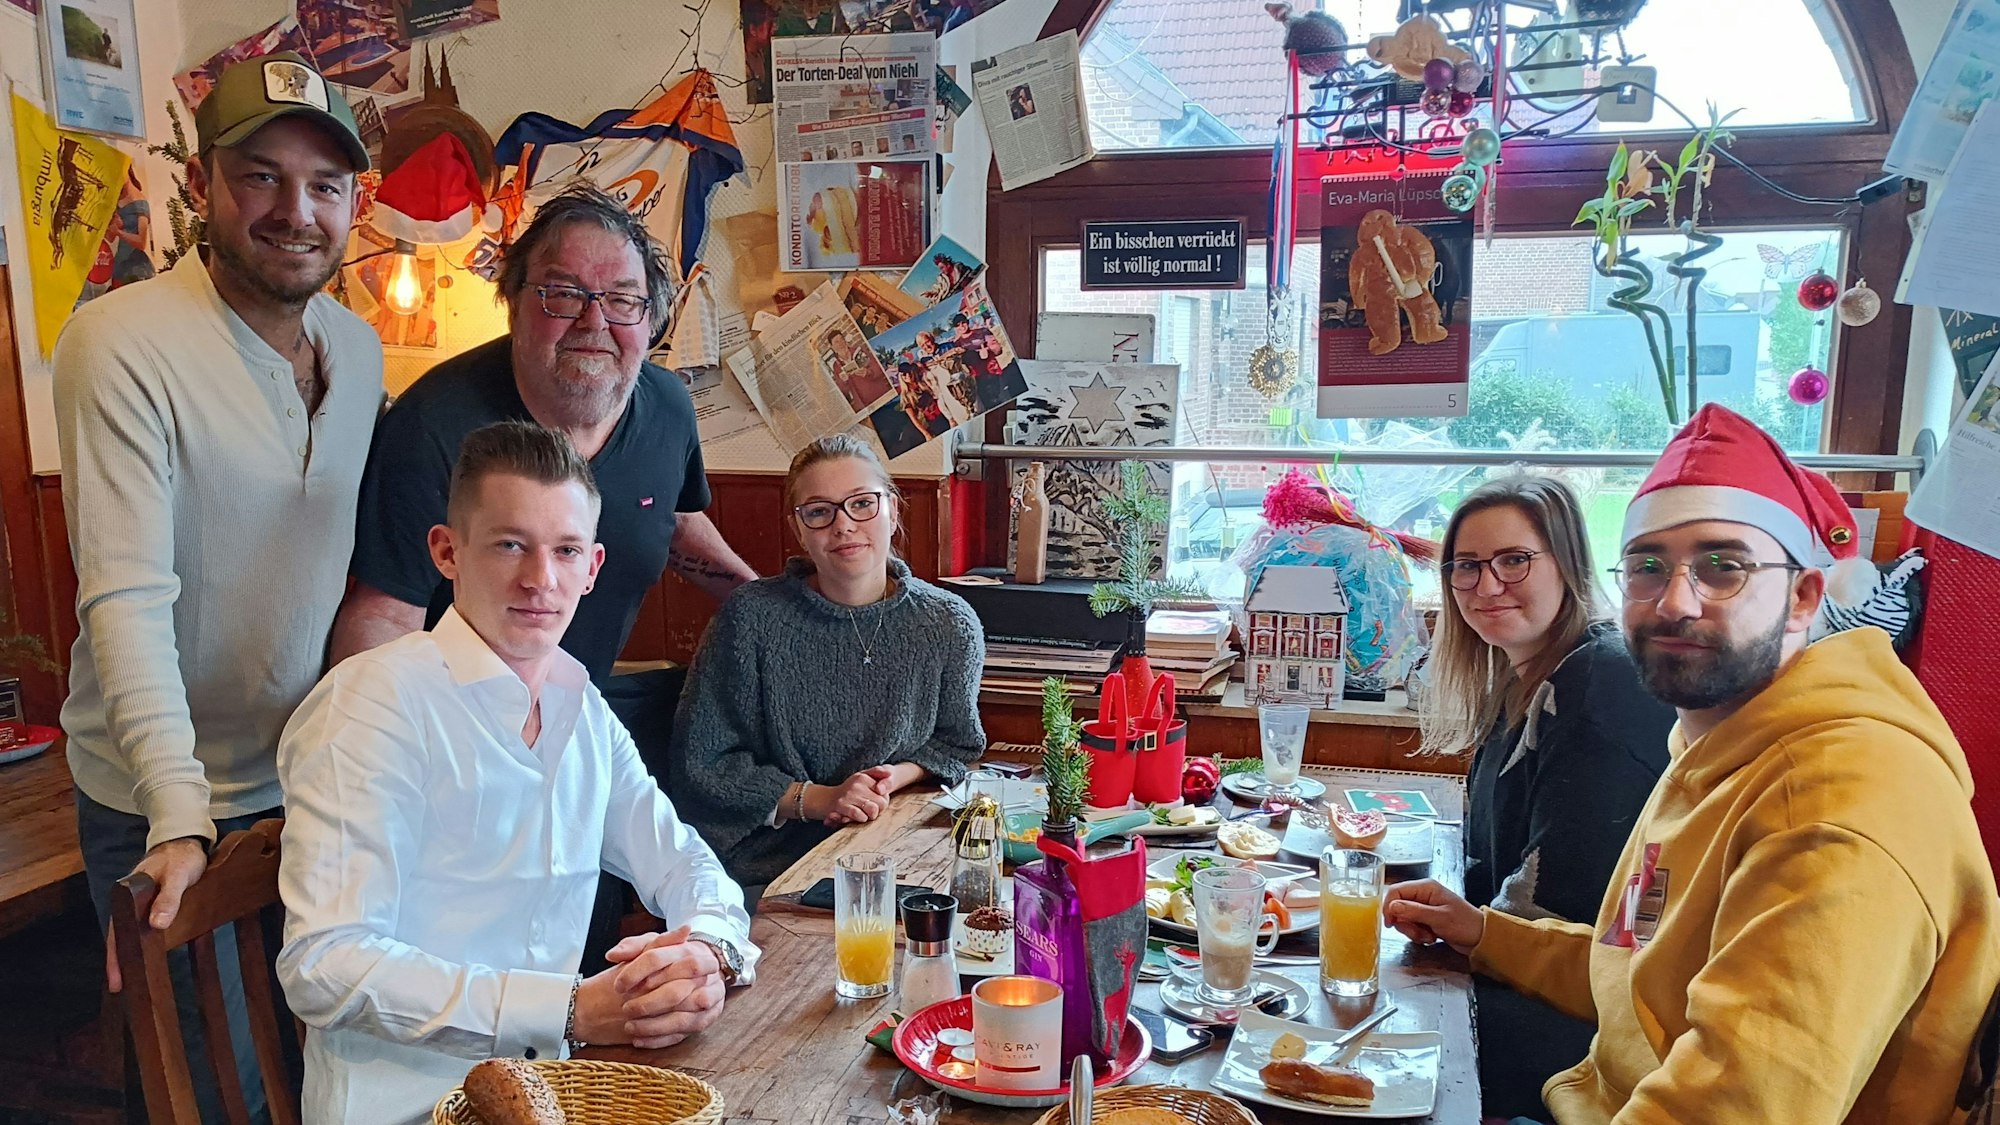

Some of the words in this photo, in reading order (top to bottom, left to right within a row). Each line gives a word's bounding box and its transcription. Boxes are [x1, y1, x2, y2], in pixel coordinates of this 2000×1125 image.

[776, 68, 796, 82] Der
[798, 64, 862, 82] Torten-Deal
[866, 66, 887, 79] von
[889, 62, 919, 78] Niehl
[1328, 189, 1395, 206] Eva-Maria
[1400, 187, 1443, 205] Lüpsc
[790, 194, 802, 266] KONDITOREI
[1089, 232, 1112, 250] Ein
[1115, 231, 1174, 250] bisschen
[1177, 229, 1236, 248] verrückt
[1103, 256, 1121, 274] ist
[1123, 255, 1160, 277] völlig
[1163, 254, 1211, 273] normal
[1216, 254, 1222, 272] !
[1447, 393, 1457, 408] 5
[1016, 920, 1058, 957] SEARS
[1029, 949, 1043, 963] GIN
[1003, 1042, 1013, 1052] &
[1016, 1042, 1041, 1052] RAY
